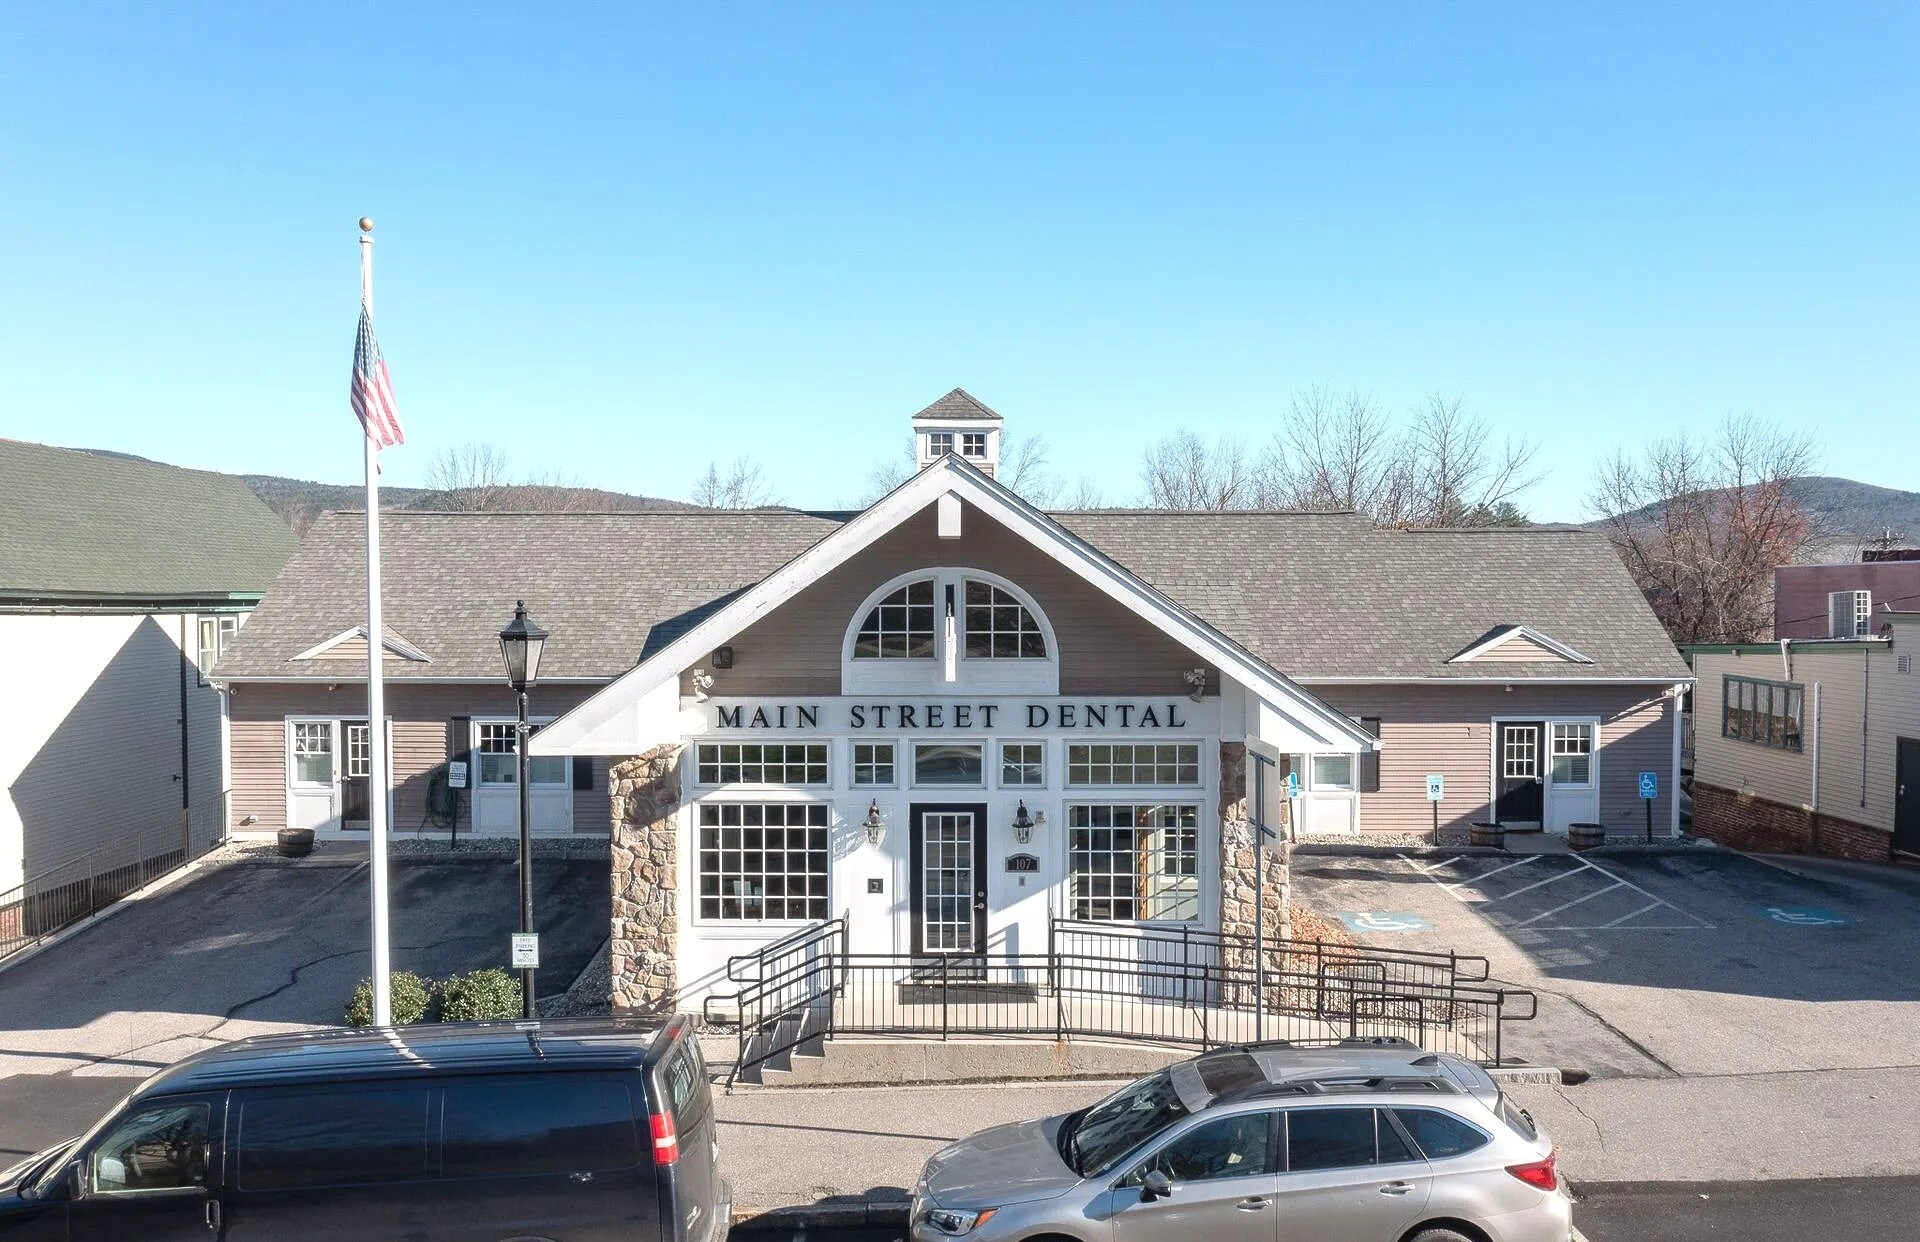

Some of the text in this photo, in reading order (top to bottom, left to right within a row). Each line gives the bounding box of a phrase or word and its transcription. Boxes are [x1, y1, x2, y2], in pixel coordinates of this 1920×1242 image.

[716, 704, 1187, 729] MAIN STREET DENTAL
[1016, 858, 1031, 870] 107
